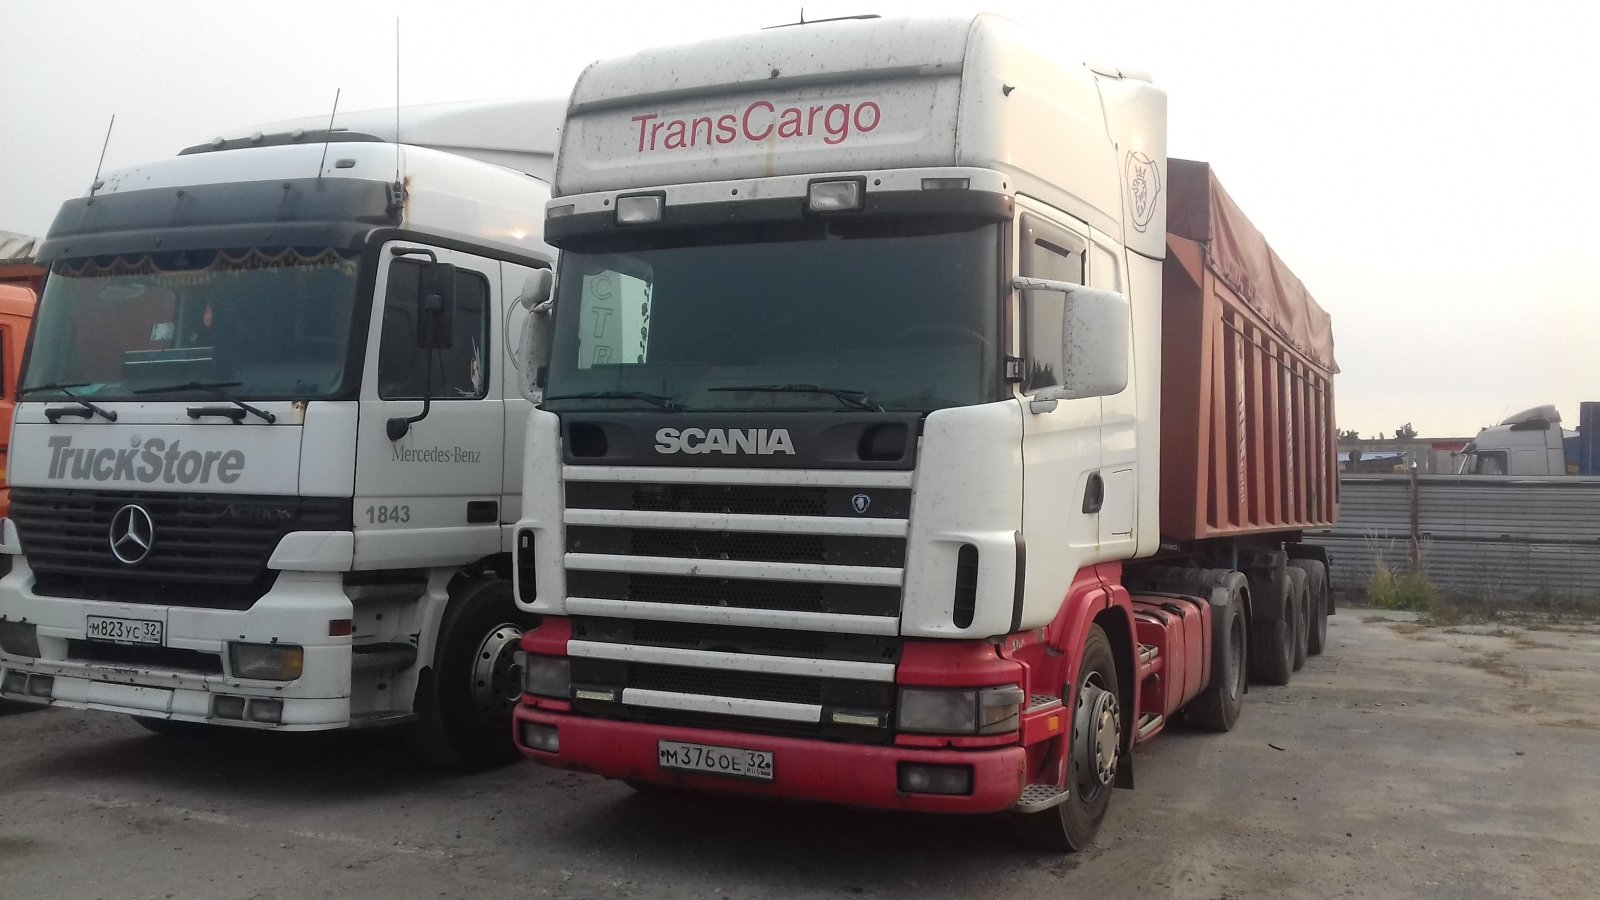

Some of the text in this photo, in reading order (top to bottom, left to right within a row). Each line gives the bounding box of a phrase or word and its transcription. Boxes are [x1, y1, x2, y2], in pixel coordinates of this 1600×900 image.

[631, 101, 881, 152] TransCargo
[654, 427, 796, 455] SCANIA
[47, 435, 246, 485] TruckStore
[392, 444, 481, 463] Mercedes-Benz
[366, 505, 411, 524] 1843
[143, 622, 157, 636] 32
[747, 752, 765, 769] 32
